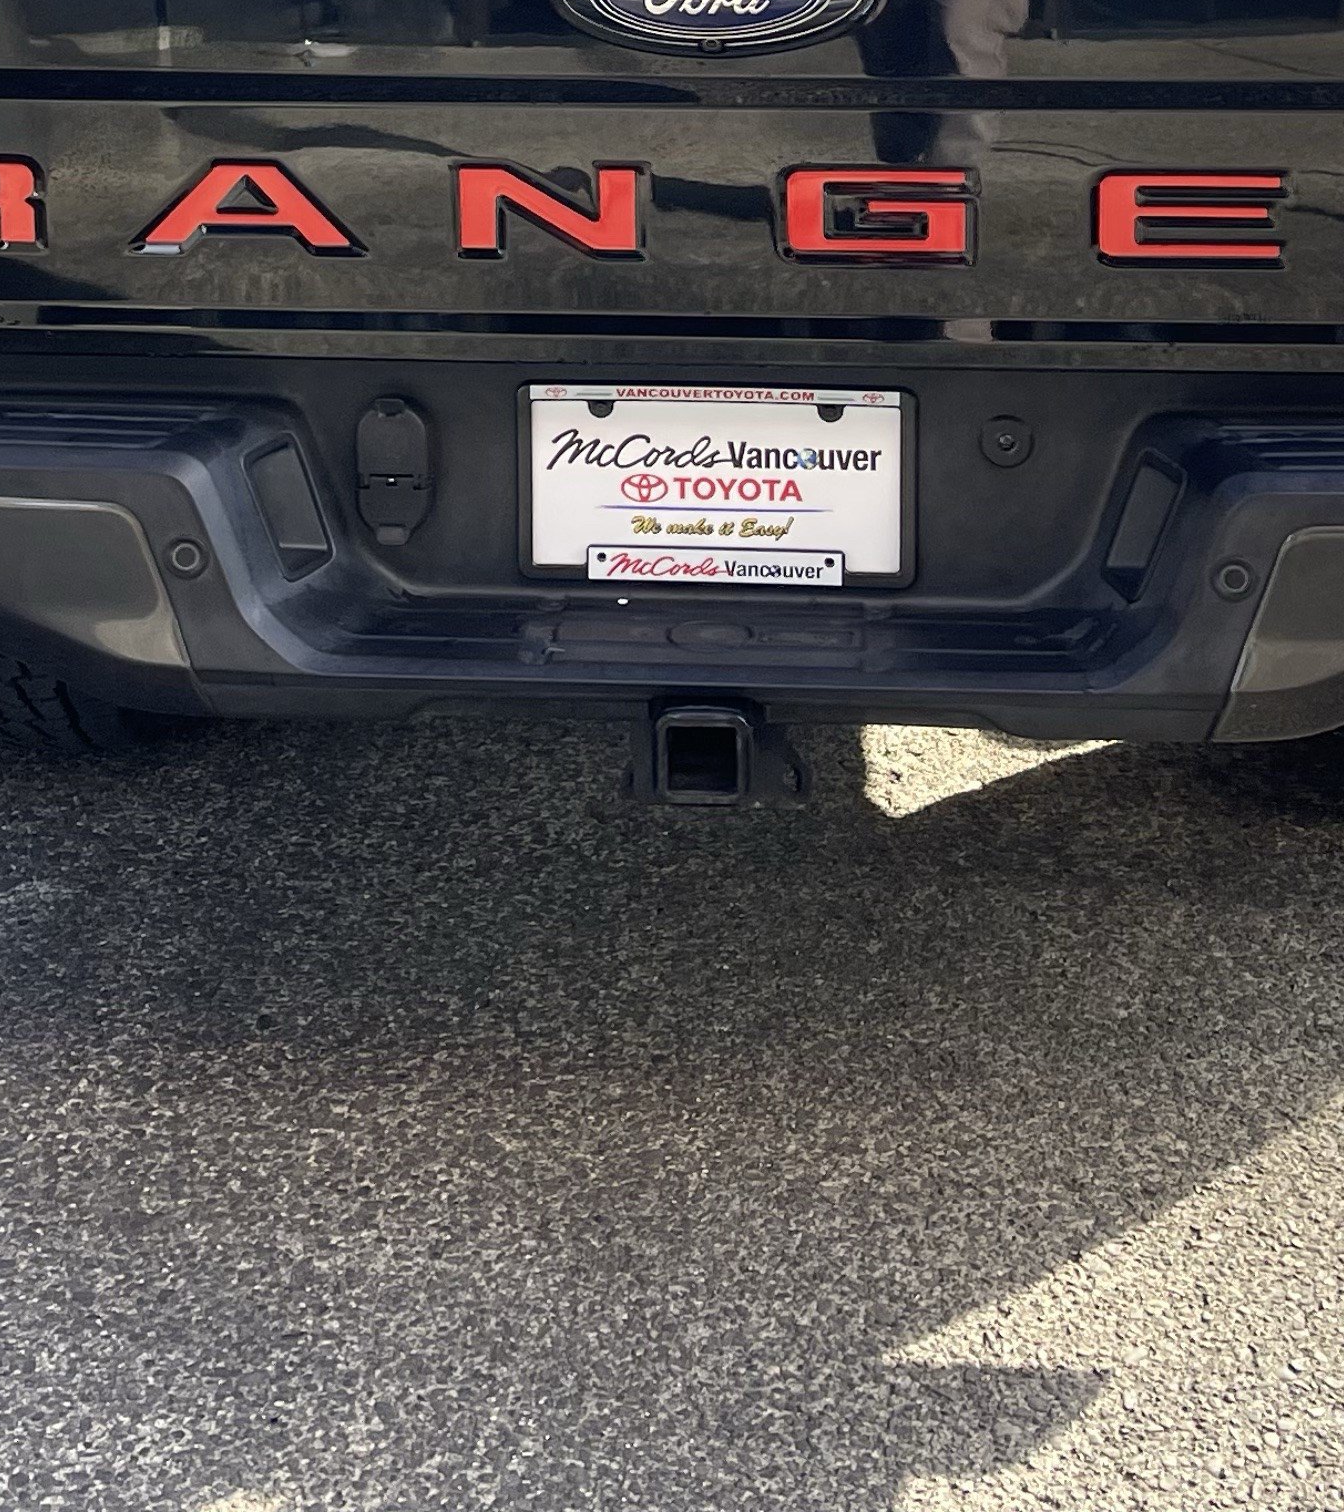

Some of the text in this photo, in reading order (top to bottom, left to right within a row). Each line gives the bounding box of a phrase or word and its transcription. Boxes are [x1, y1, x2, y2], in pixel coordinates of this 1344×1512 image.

[616, 387, 816, 402] VANCOUVERTOYOTA.COM
[673, 476, 803, 502] TOYOTA
[631, 515, 795, 541] We make it Easy!
